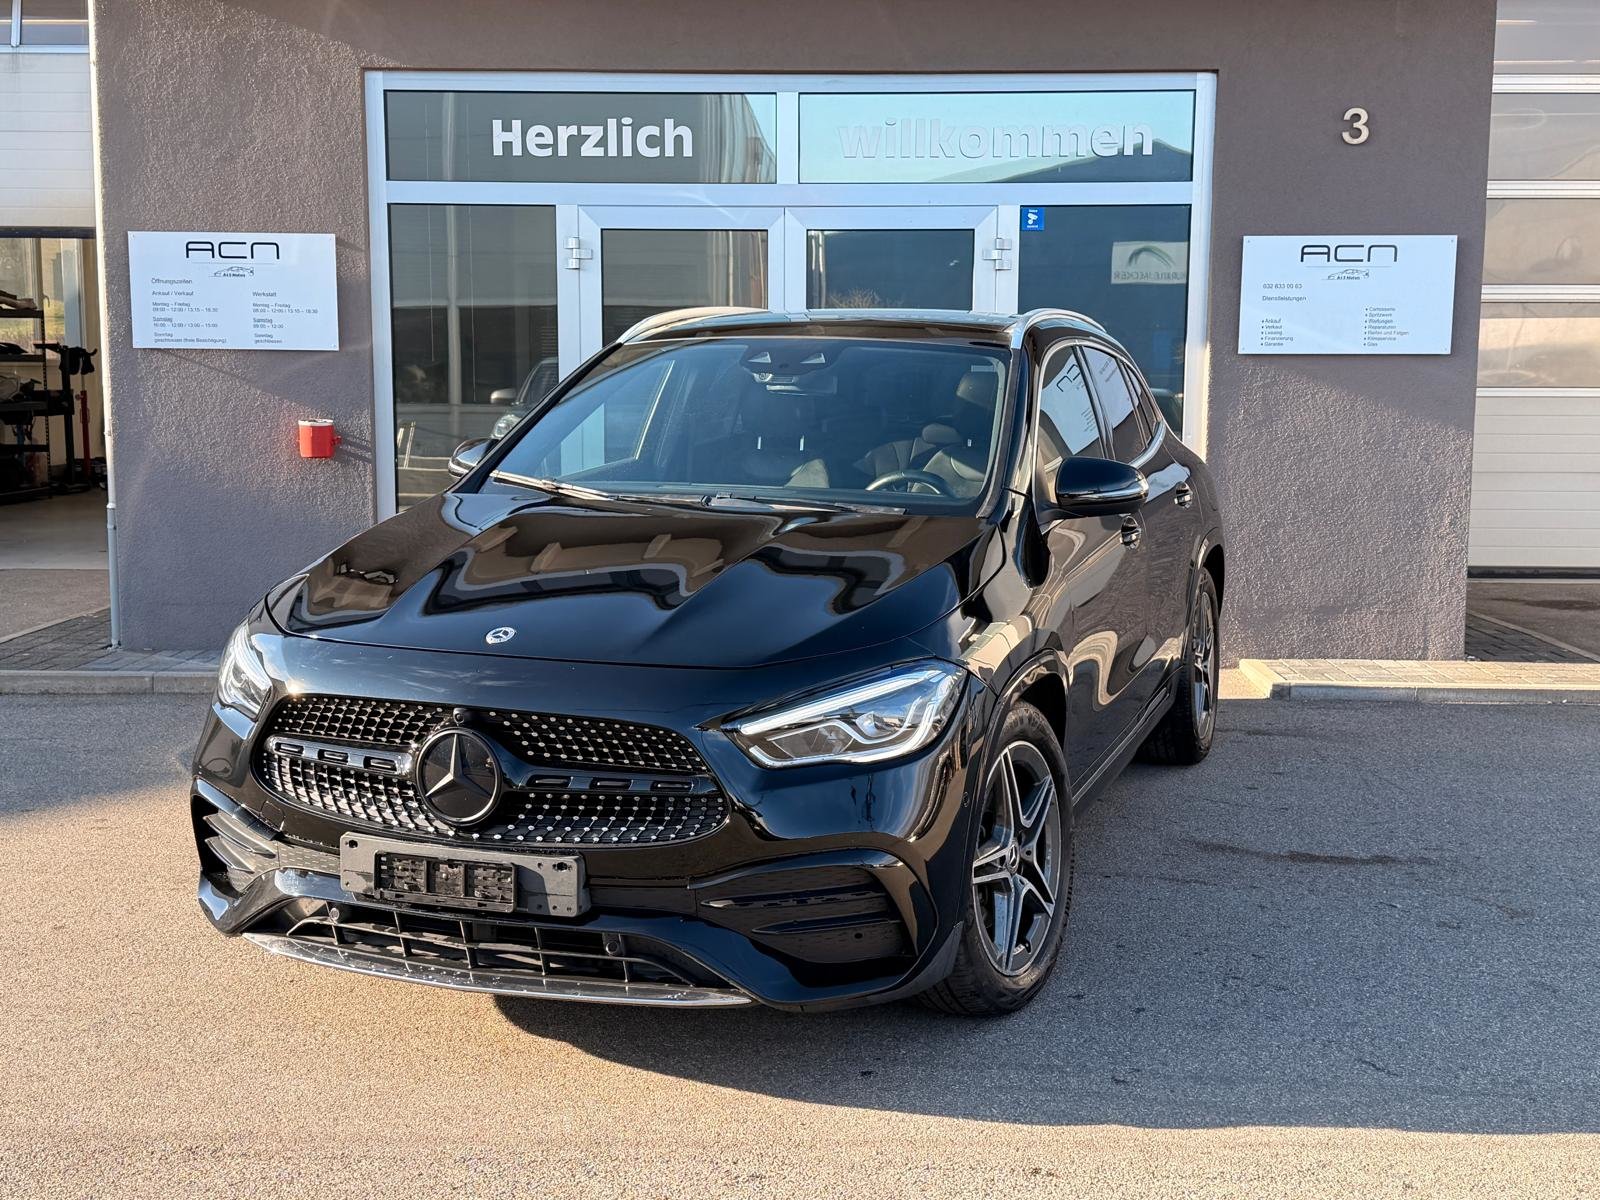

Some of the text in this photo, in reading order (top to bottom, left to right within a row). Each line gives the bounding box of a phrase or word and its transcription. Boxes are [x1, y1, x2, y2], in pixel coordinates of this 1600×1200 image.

[491, 117, 1154, 160] Herzlich willkommen
[1341, 107, 1370, 145] 3
